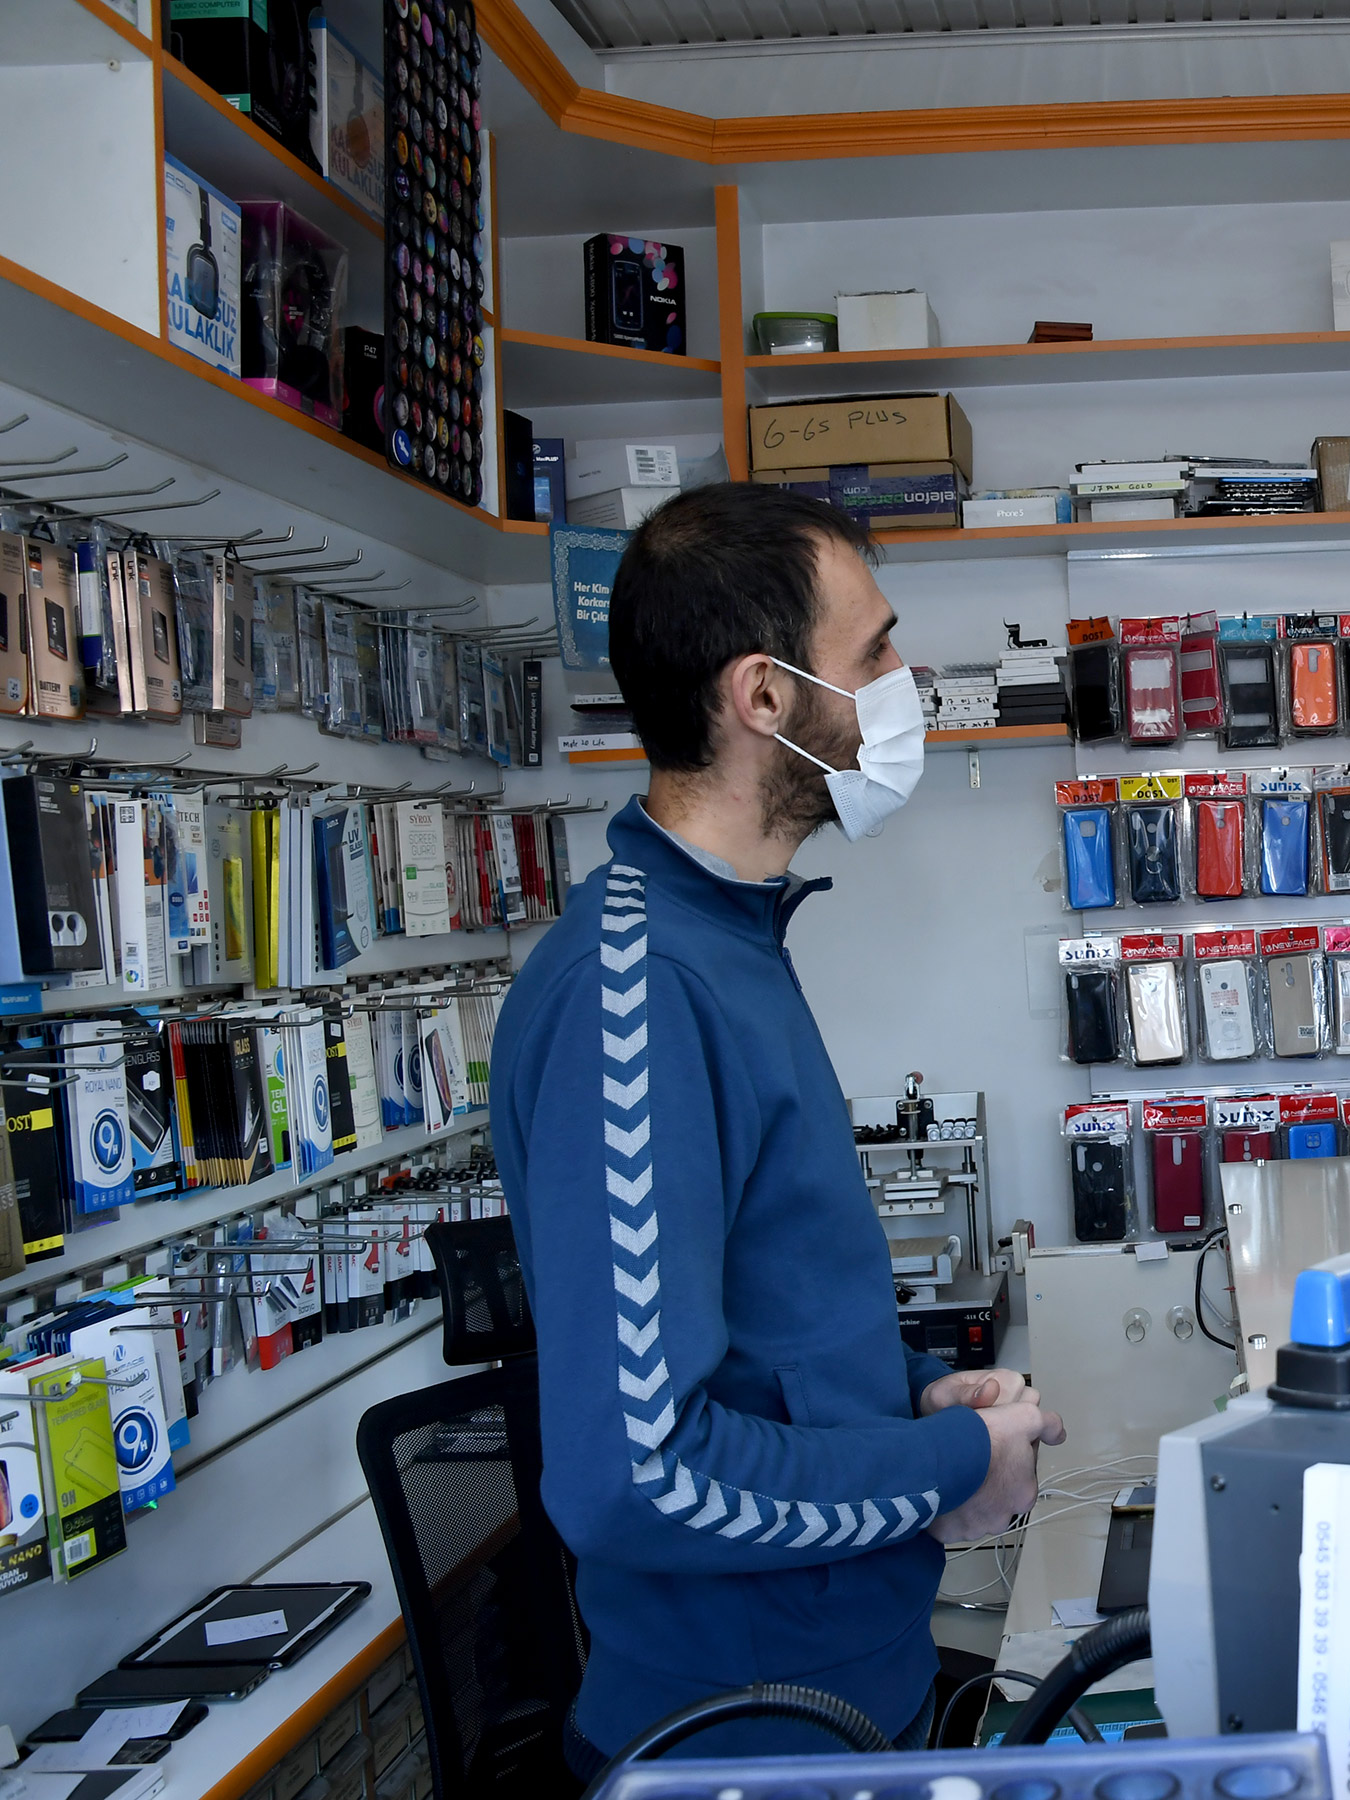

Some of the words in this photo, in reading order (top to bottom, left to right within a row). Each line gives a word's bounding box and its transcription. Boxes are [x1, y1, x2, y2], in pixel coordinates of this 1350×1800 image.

[650, 295, 677, 305] NOKIA
[848, 410, 907, 429] PLUS
[1019, 509, 1024, 517] 5
[574, 581, 590, 593] Her
[592, 583, 609, 595] Kim
[576, 609, 590, 620] Bir
[1082, 631, 1104, 642] DOST
[1132, 634, 1177, 642] NEWFACE
[1196, 783, 1243, 792] NEWFACE
[1073, 793, 1100, 803] DOST
[1137, 789, 1164, 798] DOST
[409, 814, 432, 824] SYROX
[348, 828, 359, 842] UV
[1206, 943, 1252, 953] NEWFACE
[1272, 938, 1316, 950] NEWFACE
[1134, 946, 1180, 956] NEWFACE
[326, 1047, 338, 1058] OST
[85, 1080, 105, 1093] ROYAL
[1290, 1107, 1335, 1117] NEWFACE
[6, 1114, 31, 1133] OST
[1158, 1115, 1203, 1125] NEWFACE
[61, 1489, 76, 1508] 9H
[9, 1544, 42, 1566] NANO
[1314, 1569, 1330, 1600] 383
[1313, 1607, 1329, 1628] 39
[1312, 1633, 1328, 1655] 39
